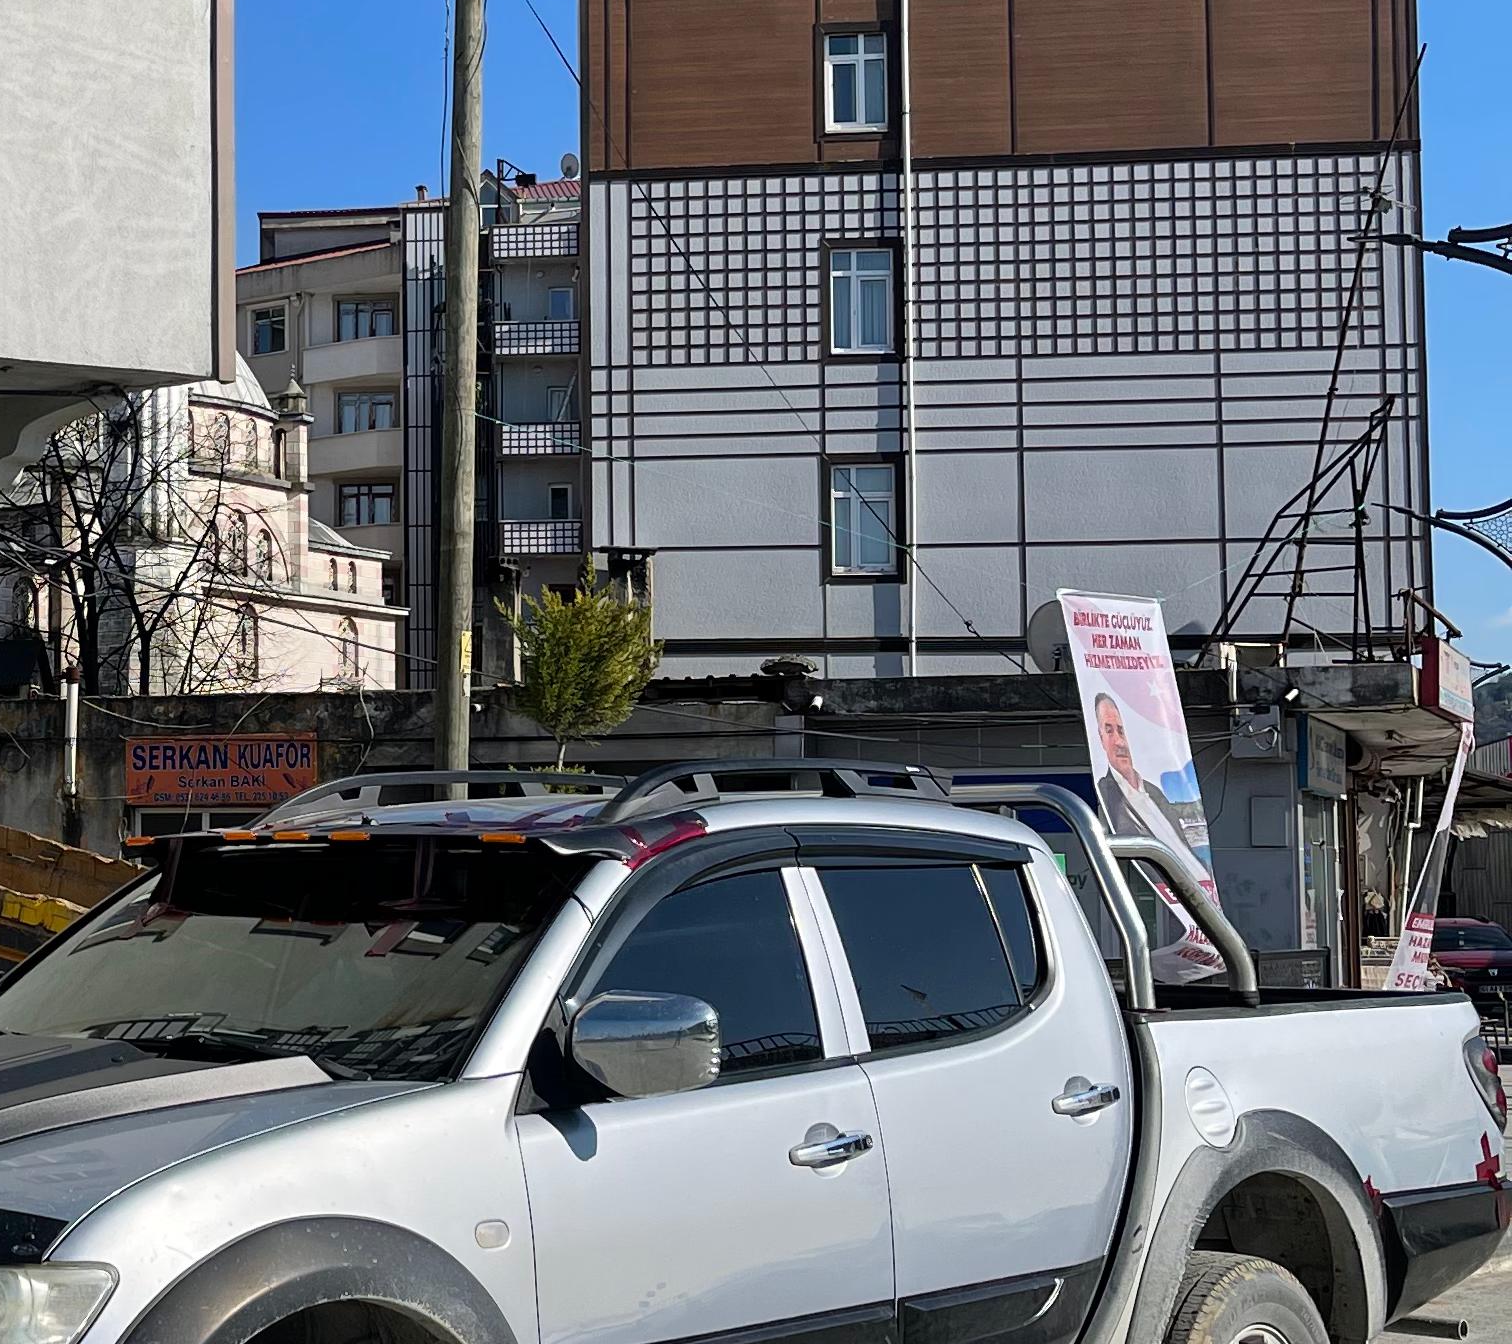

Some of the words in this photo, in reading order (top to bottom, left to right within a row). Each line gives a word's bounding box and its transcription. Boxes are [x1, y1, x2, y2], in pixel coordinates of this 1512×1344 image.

[1092, 634, 1108, 649] HER
[1109, 634, 1142, 650] ZAMAN
[132, 744, 228, 770] SERKAN
[178, 775, 225, 788] Serkan
